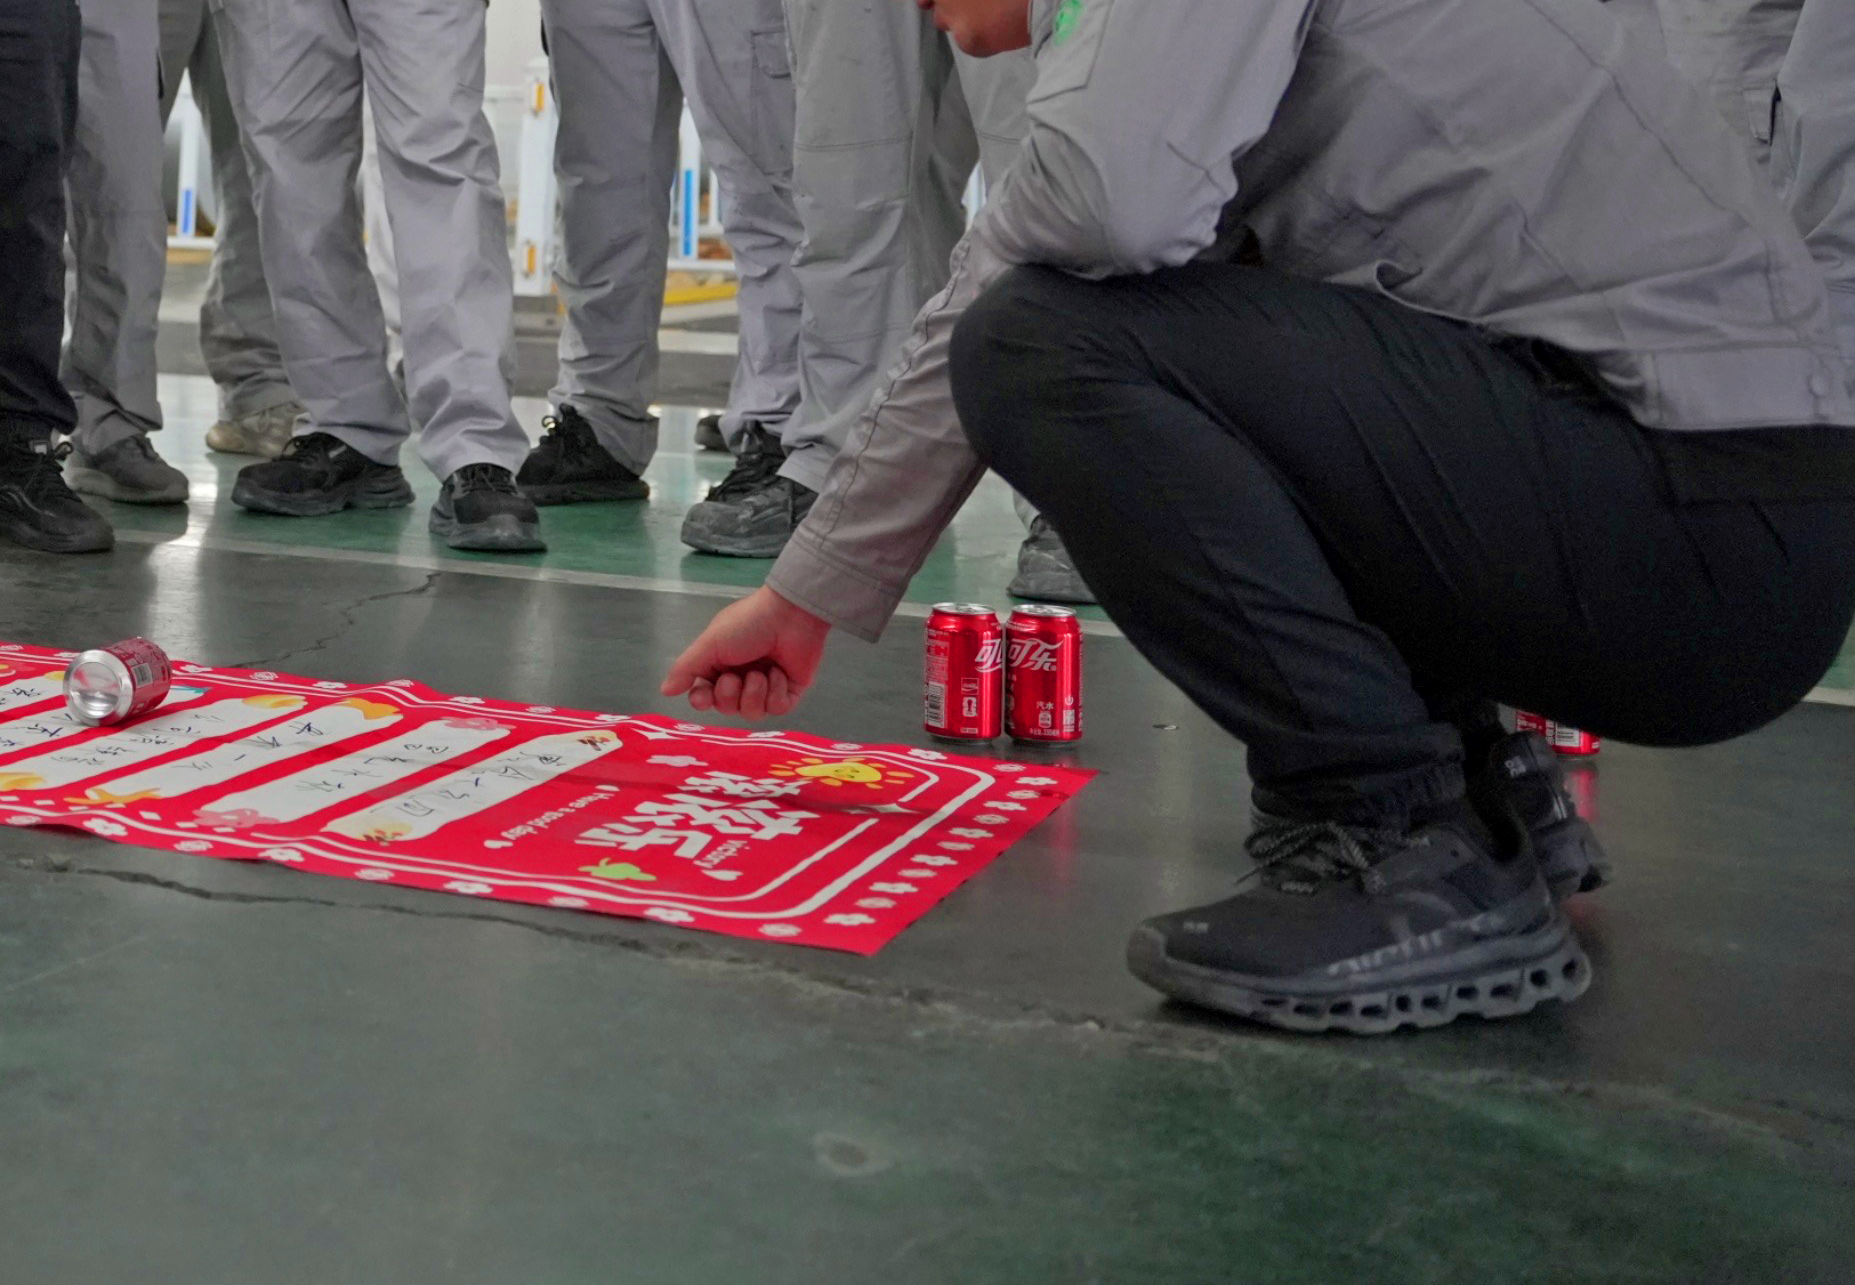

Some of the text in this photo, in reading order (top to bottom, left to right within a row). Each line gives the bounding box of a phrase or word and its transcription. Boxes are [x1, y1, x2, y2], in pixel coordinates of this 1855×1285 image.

[568, 792, 615, 808] Have
[526, 811, 565, 828] good
[575, 770, 820, 860] 滚滚乐
[500, 824, 539, 840] day
[693, 839, 751, 868] victory
